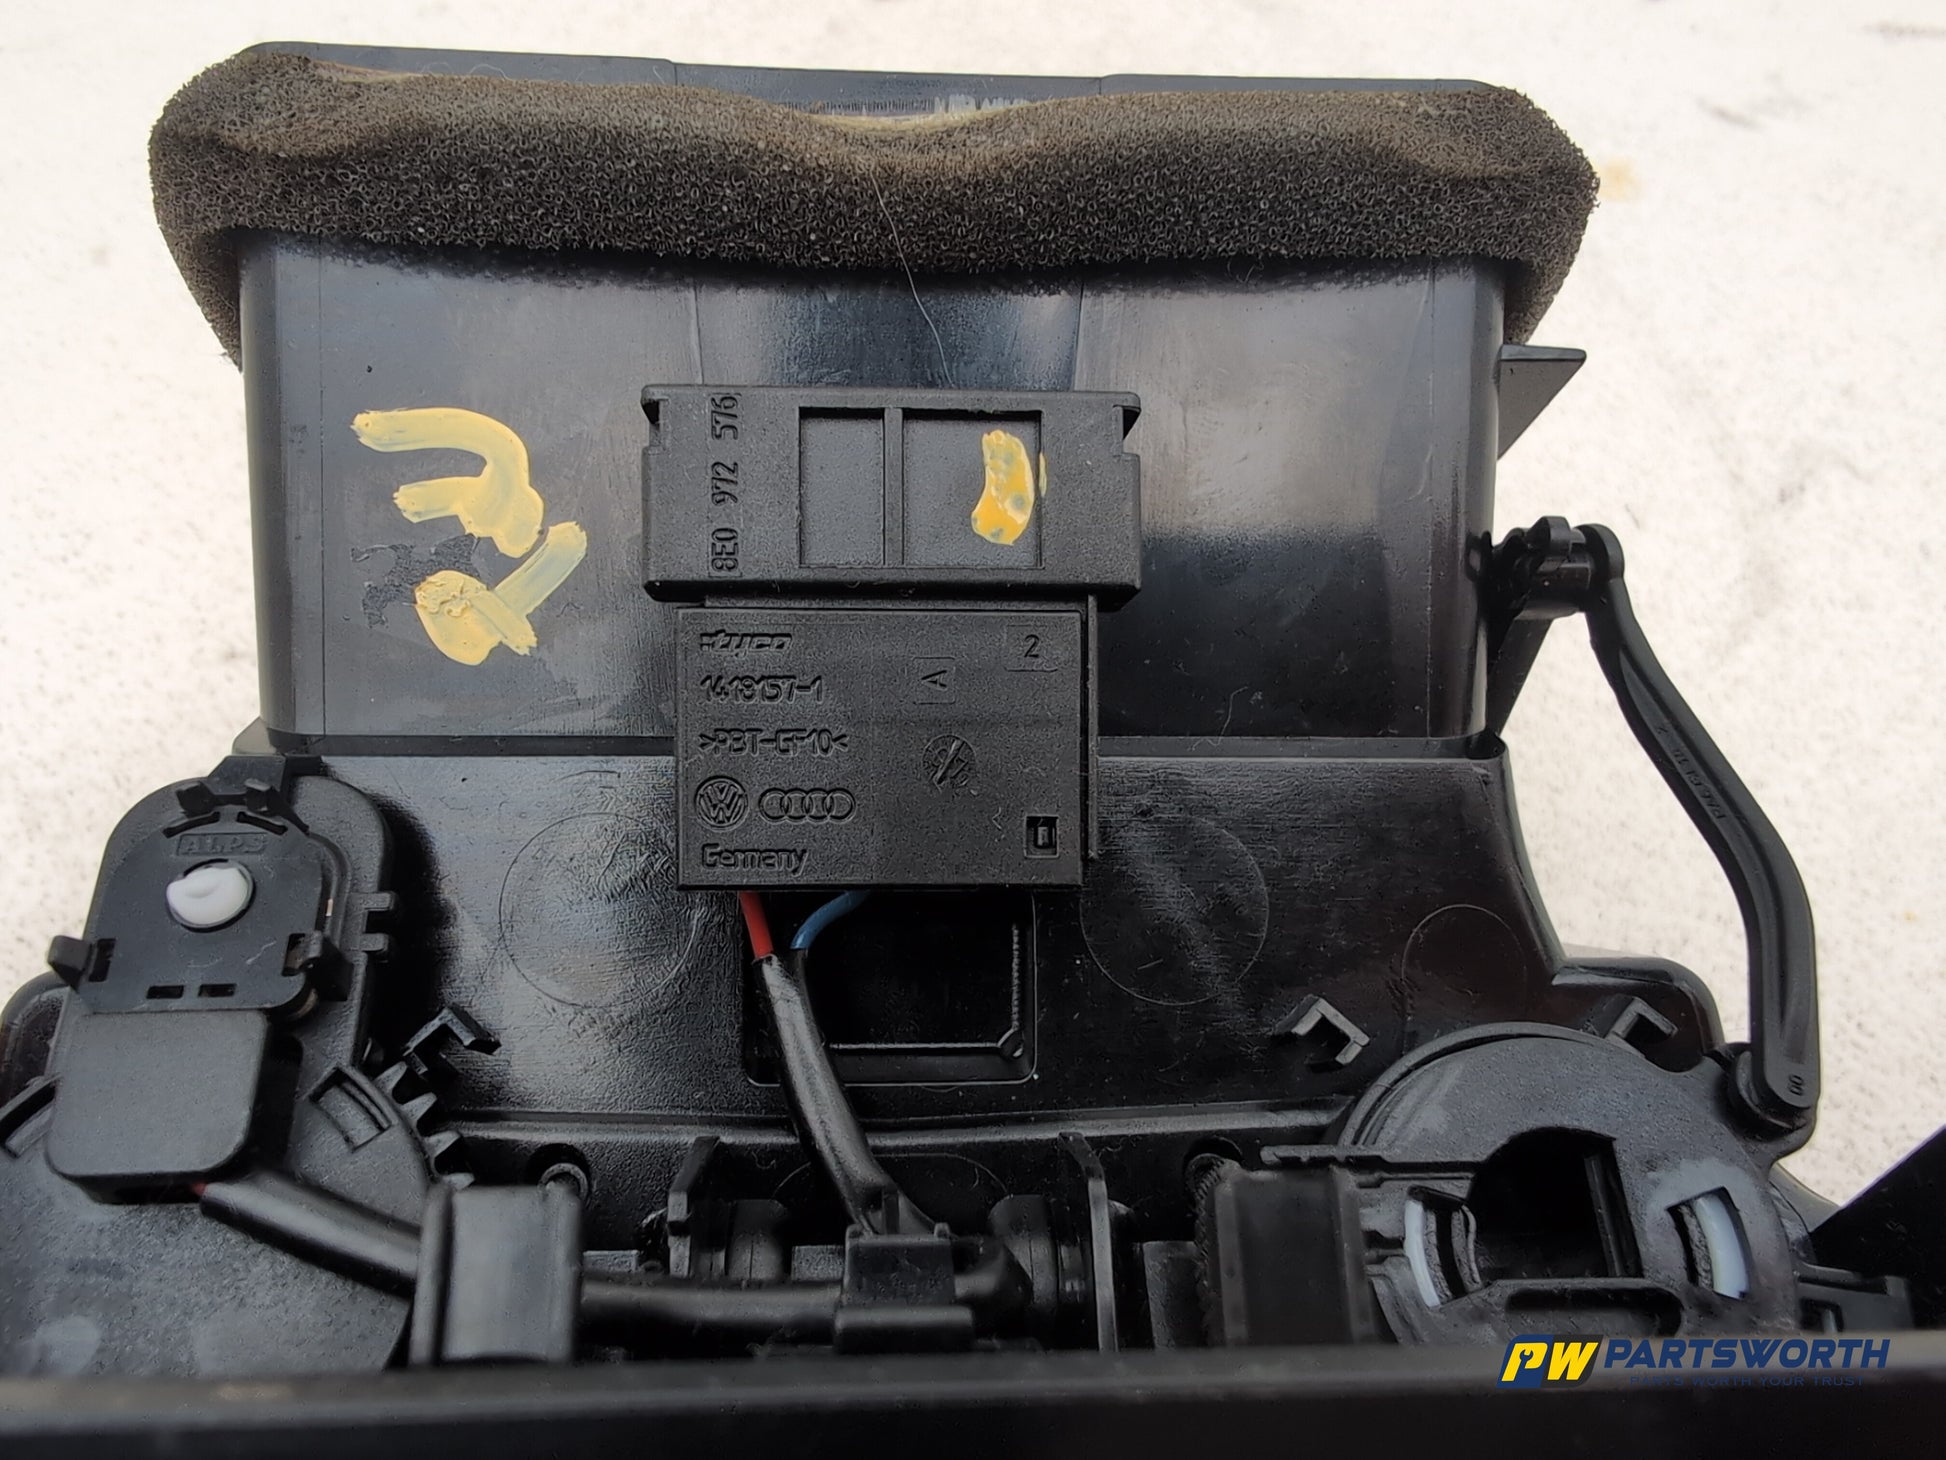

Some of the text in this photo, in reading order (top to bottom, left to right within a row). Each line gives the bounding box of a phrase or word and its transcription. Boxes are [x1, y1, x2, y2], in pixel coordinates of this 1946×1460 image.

[711, 395, 738, 440] 576
[1023, 635, 1040, 659] 2
[701, 843, 808, 876] Germany
